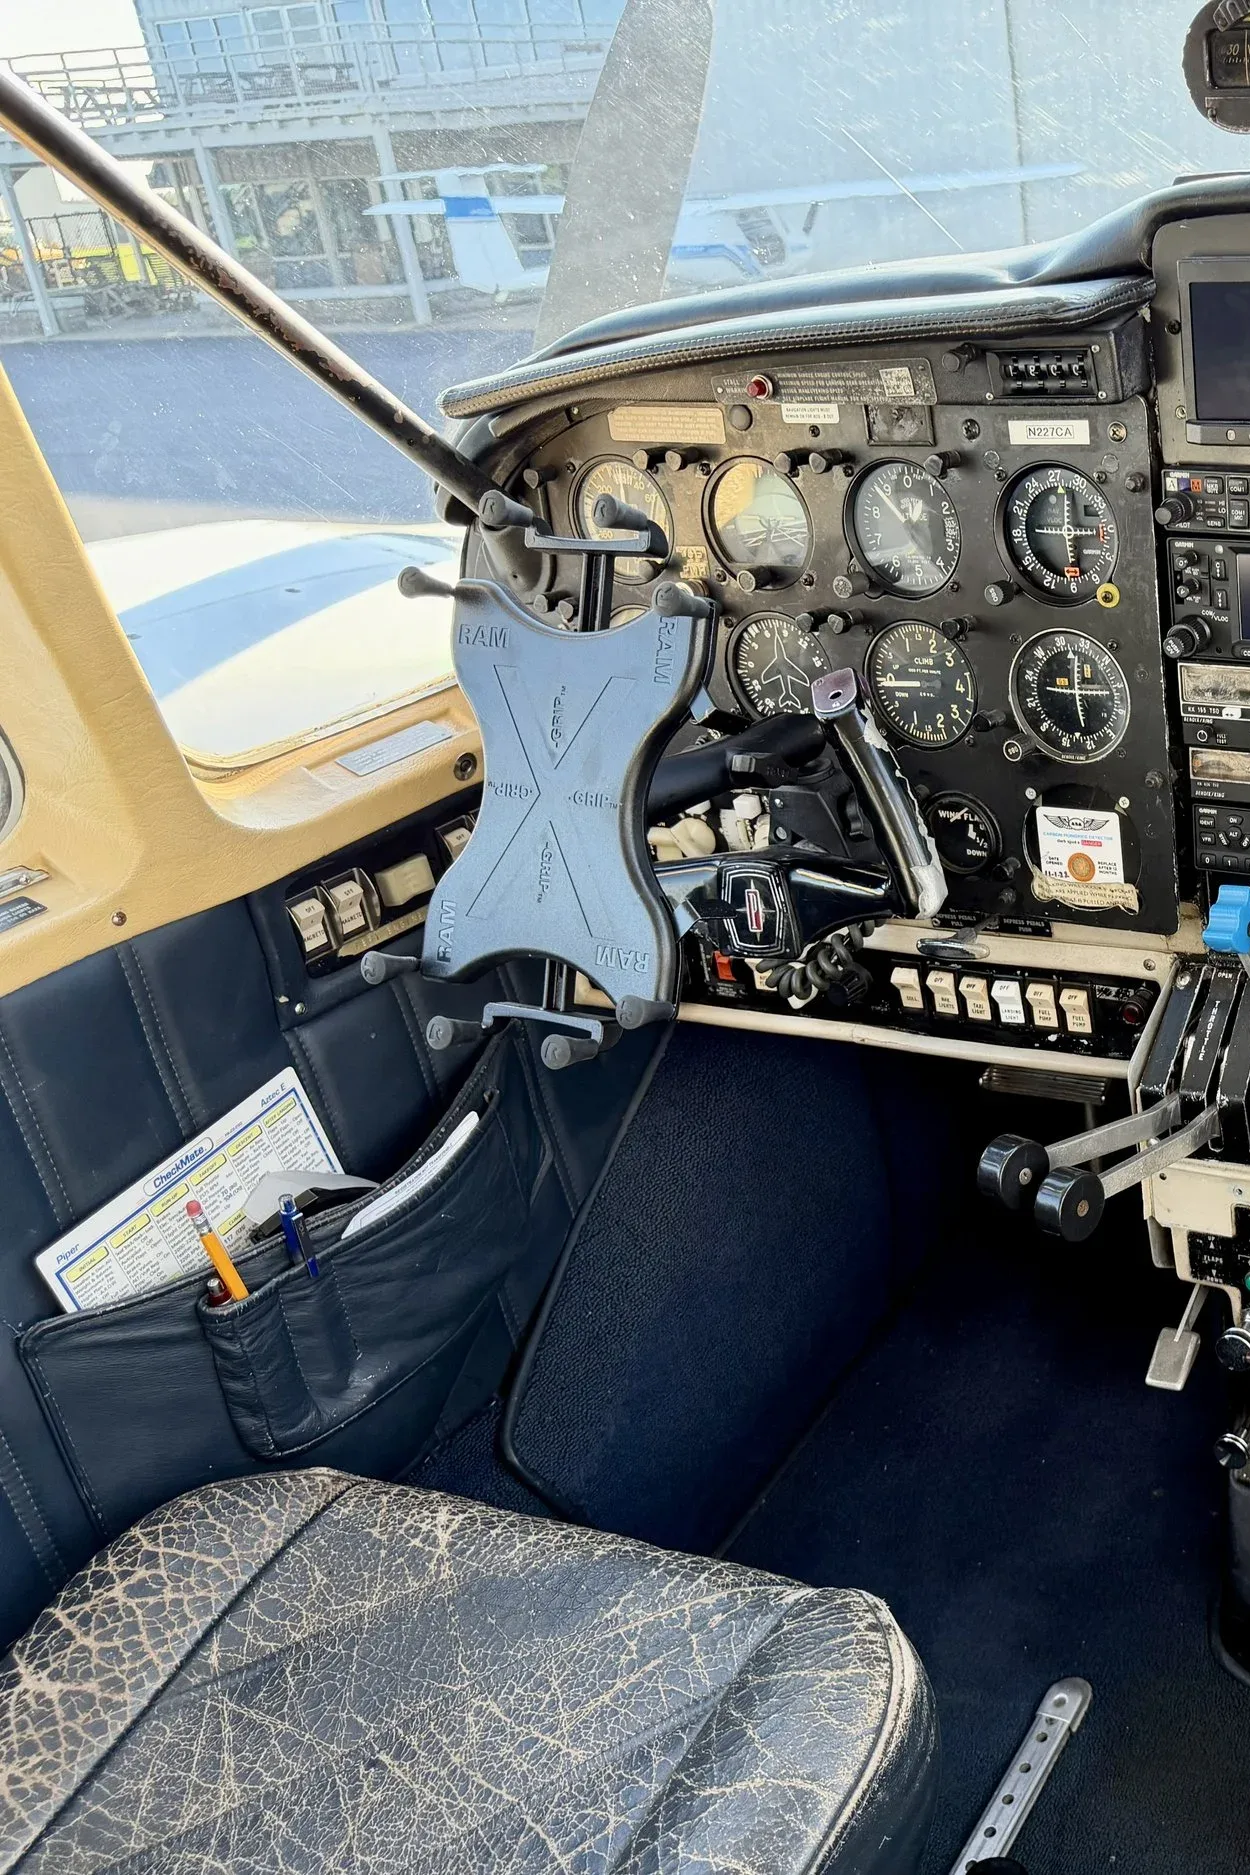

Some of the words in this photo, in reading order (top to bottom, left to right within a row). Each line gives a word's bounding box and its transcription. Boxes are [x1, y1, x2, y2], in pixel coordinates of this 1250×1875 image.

[1226, 43, 1239, 56] 30
[1028, 427, 1073, 437] N227CA
[459, 624, 510, 648] RAM
[654, 615, 678, 686] RAM
[914, 657, 934, 665] CLIMB
[437, 900, 457, 964] RAM
[595, 945, 650, 973] RAM
[1217, 971, 1233, 979] OPEN
[1198, 1000, 1221, 1061] THROTTLE
[260, 1089, 281, 1108] Aztec
[280, 1083, 286, 1092] E
[153, 1145, 204, 1189] CheckMate
[56, 1243, 80, 1265] Piper
